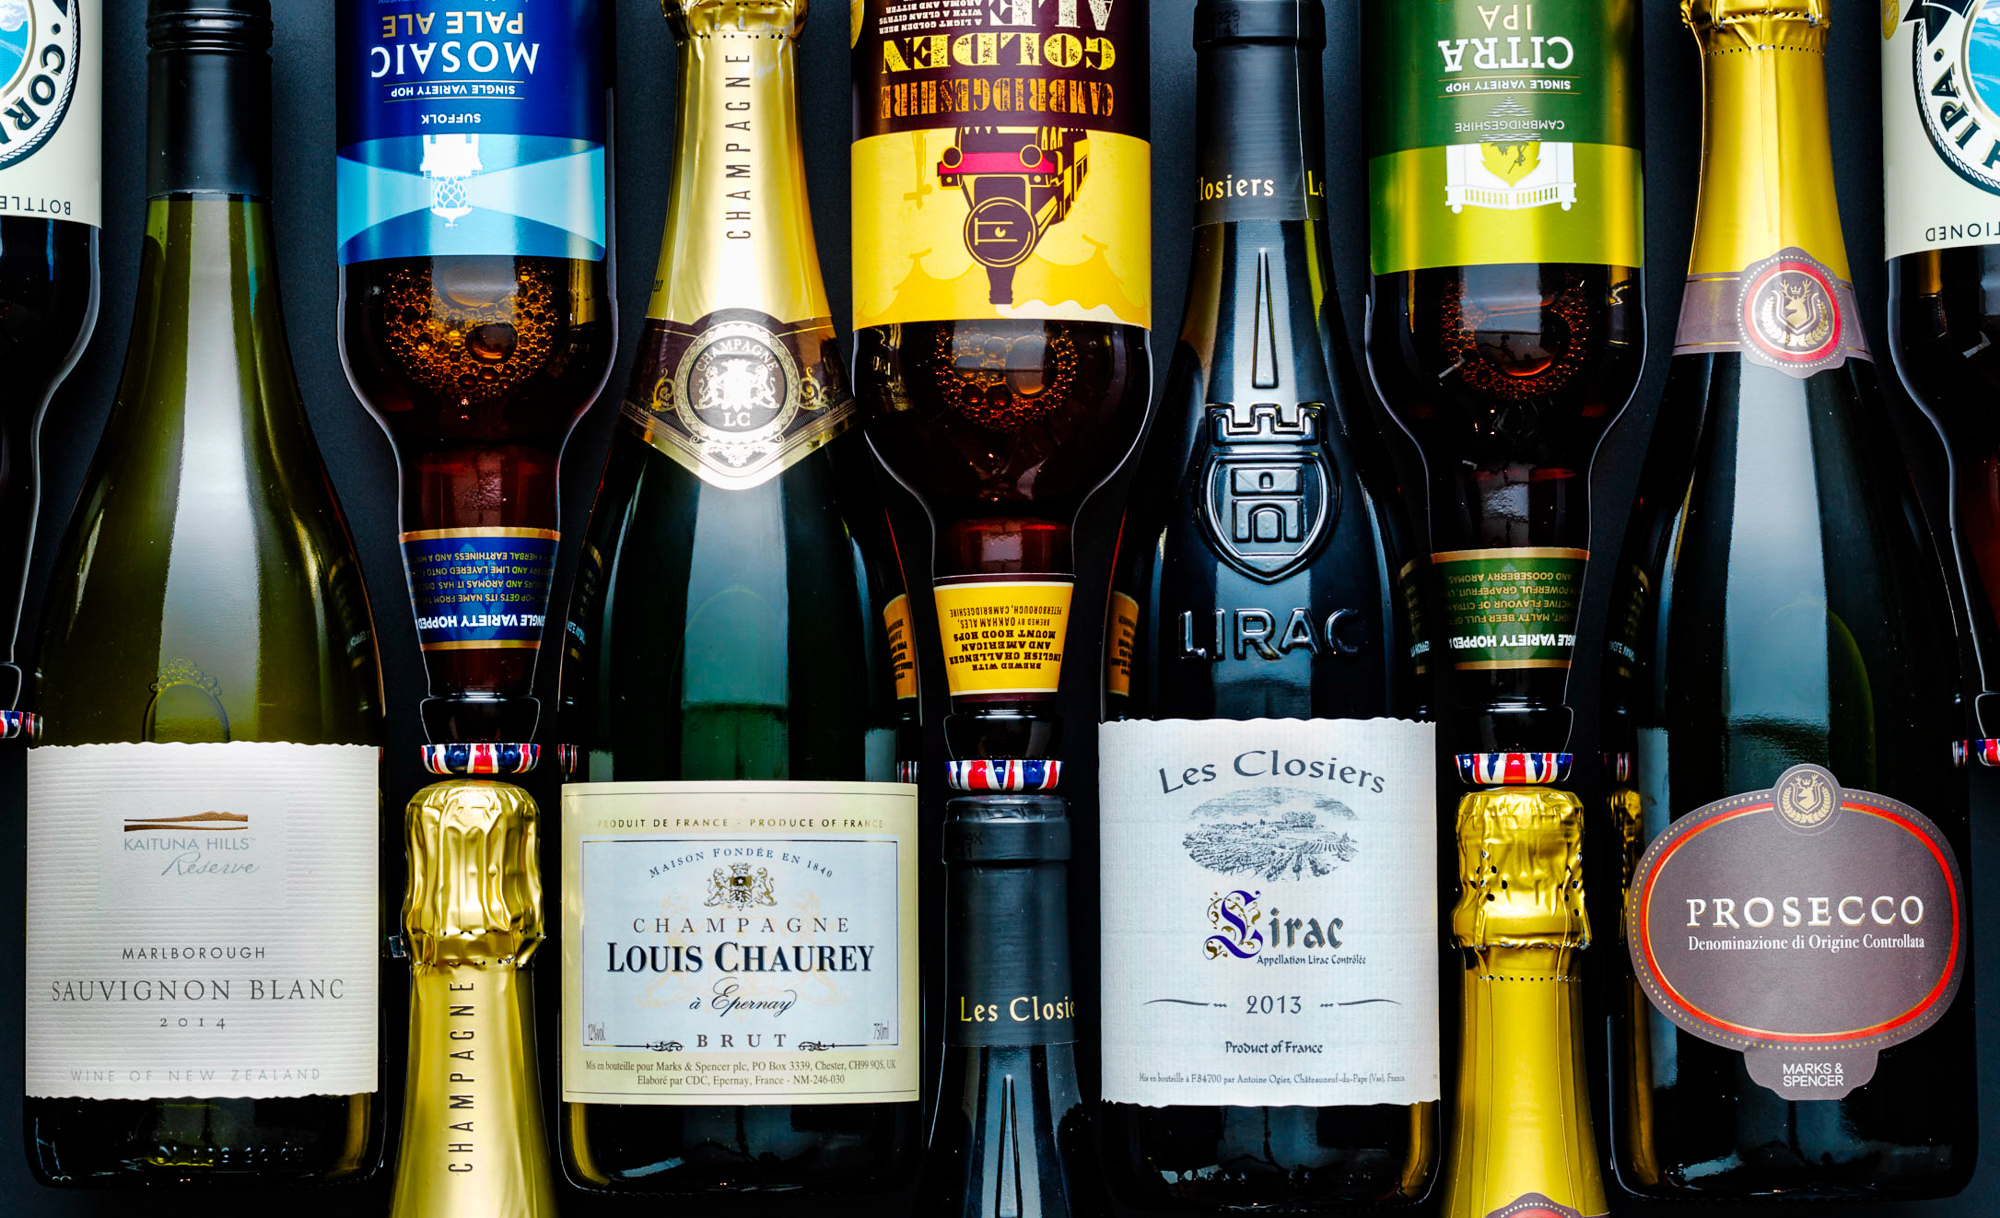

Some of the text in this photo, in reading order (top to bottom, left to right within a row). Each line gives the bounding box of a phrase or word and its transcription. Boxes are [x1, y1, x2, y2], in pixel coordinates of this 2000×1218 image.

[885, 3, 917, 14] BITTER
[919, 1, 940, 9] AND
[879, 14, 907, 24] CITRUS
[910, 11, 940, 21] CLEAN
[942, 10, 950, 18] A
[989, 0, 1114, 31] ALE
[1477, 4, 1532, 31] IPA
[382, 11, 523, 37] PALE ALE
[901, 21, 936, 31] GOLDEN
[939, 19, 971, 27] LIGHT
[879, 25, 899, 34] BEER
[881, 32, 1116, 73] GOLDEN
[1438, 36, 1574, 72] CITRA
[370, 41, 539, 77] MOSAIC
[391, 85, 515, 97] SINGLE VARIETY HOP
[1445, 80, 1571, 92] SINGLE VARIETY HOP
[880, 77, 1114, 119] CAMBRIDGESHIRE
[1931, 61, 1981, 150] IPA
[421, 113, 481, 124] SUFFOLK
[1454, 119, 1565, 132] CAMBRIDGESHIRE
[725, 55, 751, 239] CHAMPAGNE
[1196, 174, 1274, 202] losiers
[695, 339, 780, 372] CHAMPAGNE
[723, 413, 751, 426] LC
[435, 553, 452, 561] AND
[455, 552, 507, 561] EARTHINESS
[510, 552, 537, 560] HERBAL
[427, 567, 447, 576] ONTO
[450, 566, 488, 575] LAYERED
[490, 566, 510, 574] LIME
[1487, 572, 1553, 581] GOOSEBERRY
[1556, 573, 1571, 581] AND
[457, 580, 464, 588] IT
[466, 580, 504, 588] AROMAS
[1520, 586, 1568, 594] POWERFUL
[434, 595, 455, 603] FROM
[458, 594, 482, 602] NAME
[485, 594, 498, 602] ITS
[1494, 599, 1541, 608] FLAVOUR
[950, 605, 1062, 617] PETERBOROUGH, CAMBRIDGESHIRE
[1478, 601, 1491, 609] OF
[418, 616, 457, 629] HOPPED
[461, 614, 518, 627] VARIETY
[958, 618, 977, 629] ALES,
[980, 617, 1015, 627] OAKHAM
[1028, 618, 1050, 626] BREWED
[1466, 616, 1486, 624] FULL
[1489, 614, 1515, 622] BEER
[1518, 613, 1549, 622] MALTY
[953, 630, 1056, 641] MOUNT HOOD HOPS
[1178, 608, 1360, 660] LIRAC
[1500, 634, 1556, 646] VARIETY
[961, 641, 1026, 651] AMERICAN
[1453, 635, 1496, 648] HOPPED
[949, 652, 1020, 664] CHALLENGER
[1159, 750, 1385, 793] Les Closiers
[598, 819, 883, 828] PRODUIT DE FRANCE PRODUCE OF FRANCE
[124, 838, 199, 851] KAITUNA
[161, 851, 259, 876] Reserve
[649, 852, 704, 878] MAISON
[782, 853, 800, 864] EN
[807, 860, 833, 878] 1840
[1686, 895, 1925, 929] PROSECCO
[633, 918, 850, 933] CHAMPAGNE
[1202, 890, 1344, 960] Lirac
[1689, 934, 1925, 952] Denominazione di Origine Controllata
[122, 947, 266, 959] MARLBOROUGH
[607, 942, 874, 973] LOUIS CHAUREY
[1257, 955, 1305, 966] Appellation
[1309, 955, 1328, 965] Lirac
[52, 979, 344, 1001] SAUVIGNON BLANC
[689, 997, 701, 1009] à
[961, 996, 998, 1022] Les
[1246, 996, 1301, 1014] 2013
[159, 1018, 226, 1029] 2014
[697, 1034, 787, 1048] BRUT
[1226, 1041, 1323, 1054] Product of France
[586, 1061, 595, 1070] Mis
[606, 1061, 634, 1070] bouteille
[636, 1064, 653, 1073] pour
[656, 1062, 682, 1071] Marks
[685, 1062, 692, 1071] &
[696, 1062, 730, 1073] Spencer
[733, 1062, 749, 1073] plc,
[752, 1062, 765, 1070] PO
[769, 1062, 786, 1071] Box
[790, 1061, 813, 1071] 3339,
[815, 1061, 847, 1071] Chester,
[849, 1060, 869, 1069] CH99
[887, 1060, 896, 1069] UK
[1783, 1064, 1843, 1074] MARKS &
[71, 1068, 321, 1082] WINE OF NEW ZEALAND
[448, 982, 474, 1172] CHAMPAGNE
[638, 1075, 845, 1087] Elaboré par CDC, Epernay, France NM-246-030
[1238, 1075, 1266, 1083] Antoine
[1294, 1073, 1367, 1084] Châteauneuf-du-Pape
[1783, 1075, 1844, 1087] SPENCER
